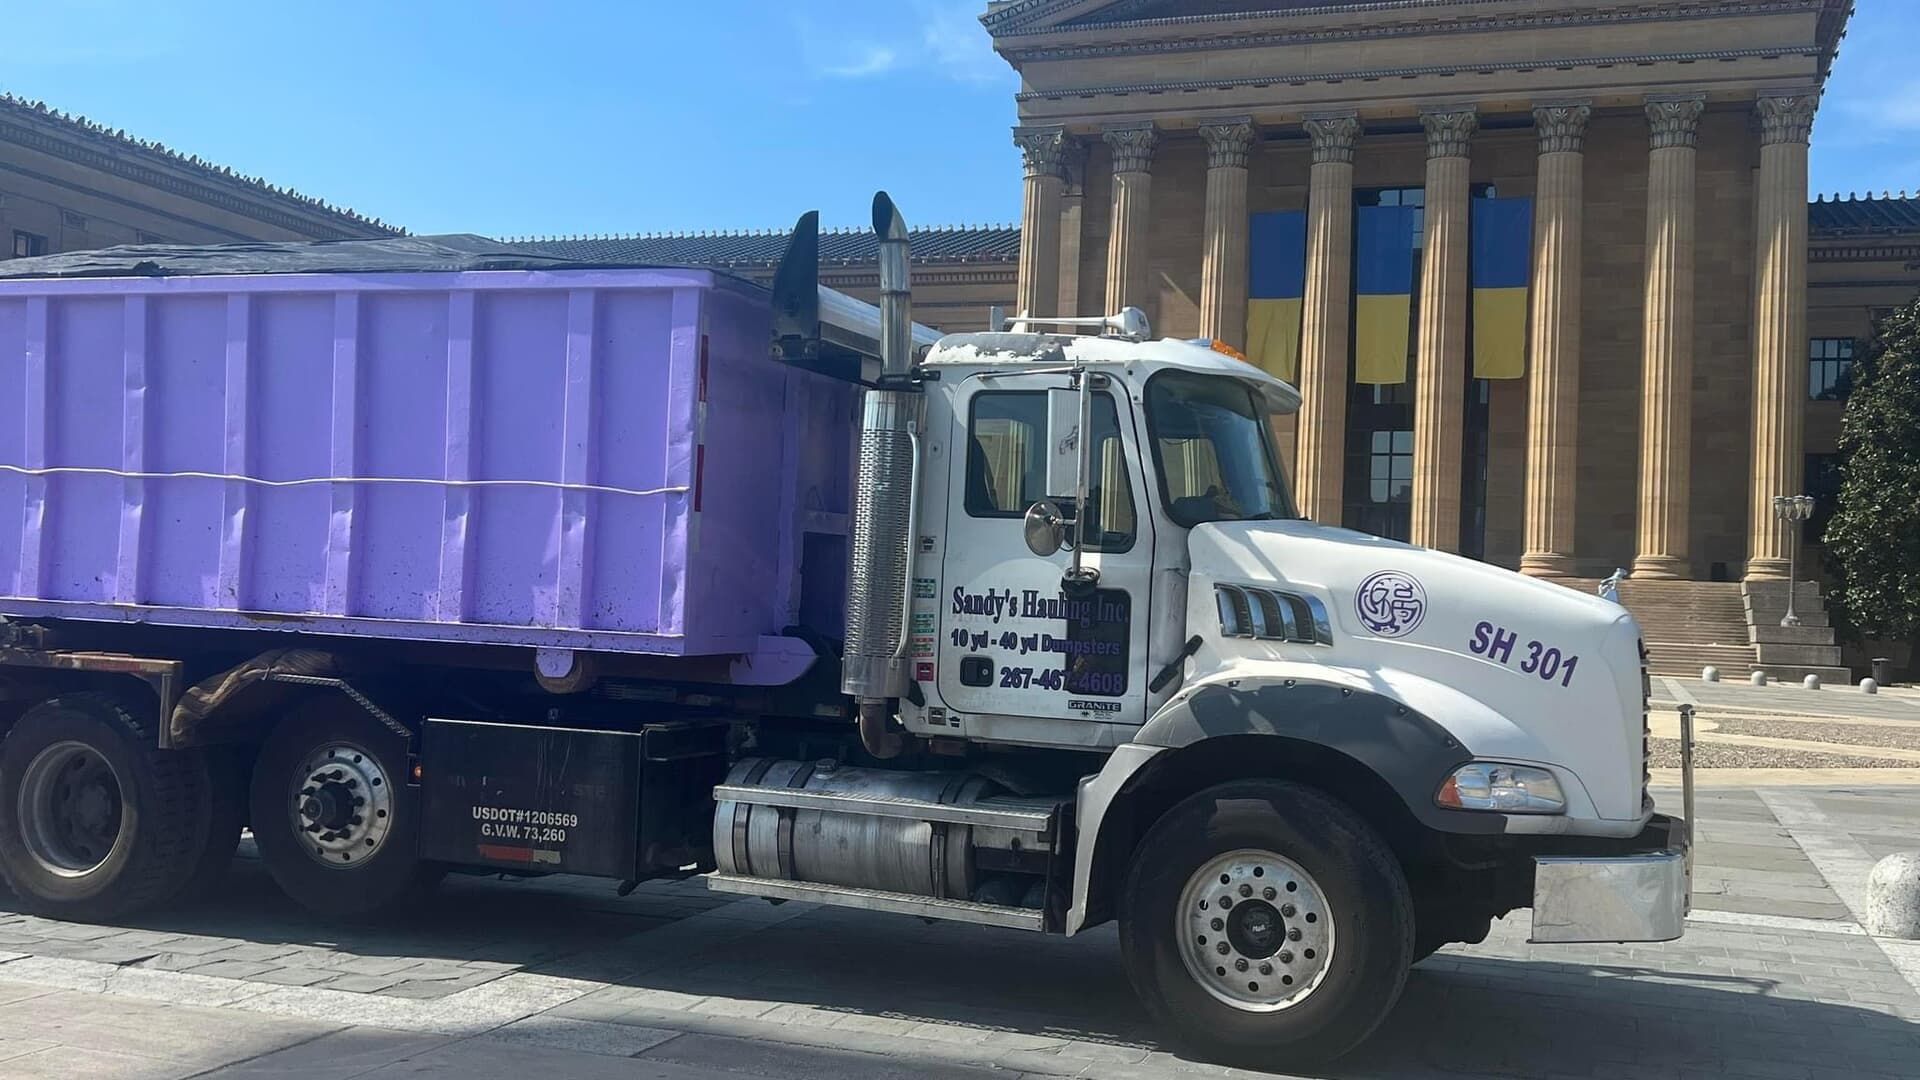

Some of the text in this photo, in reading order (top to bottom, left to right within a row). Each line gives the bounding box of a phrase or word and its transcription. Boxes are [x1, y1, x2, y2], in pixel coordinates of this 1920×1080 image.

[952, 586, 1018, 624] Sandy's
[951, 629, 969, 648] 10
[971, 631, 988, 651] yd
[1000, 632, 1018, 650] 40
[1020, 634, 1038, 654] yd
[1042, 635, 1120, 657] Dumpsters
[1469, 621, 1579, 688] SH 301
[1000, 667, 1123, 693] 267-467-4608
[472, 806, 578, 827] USDOT#1206569
[481, 824, 566, 842] G.V.W. 73,260
